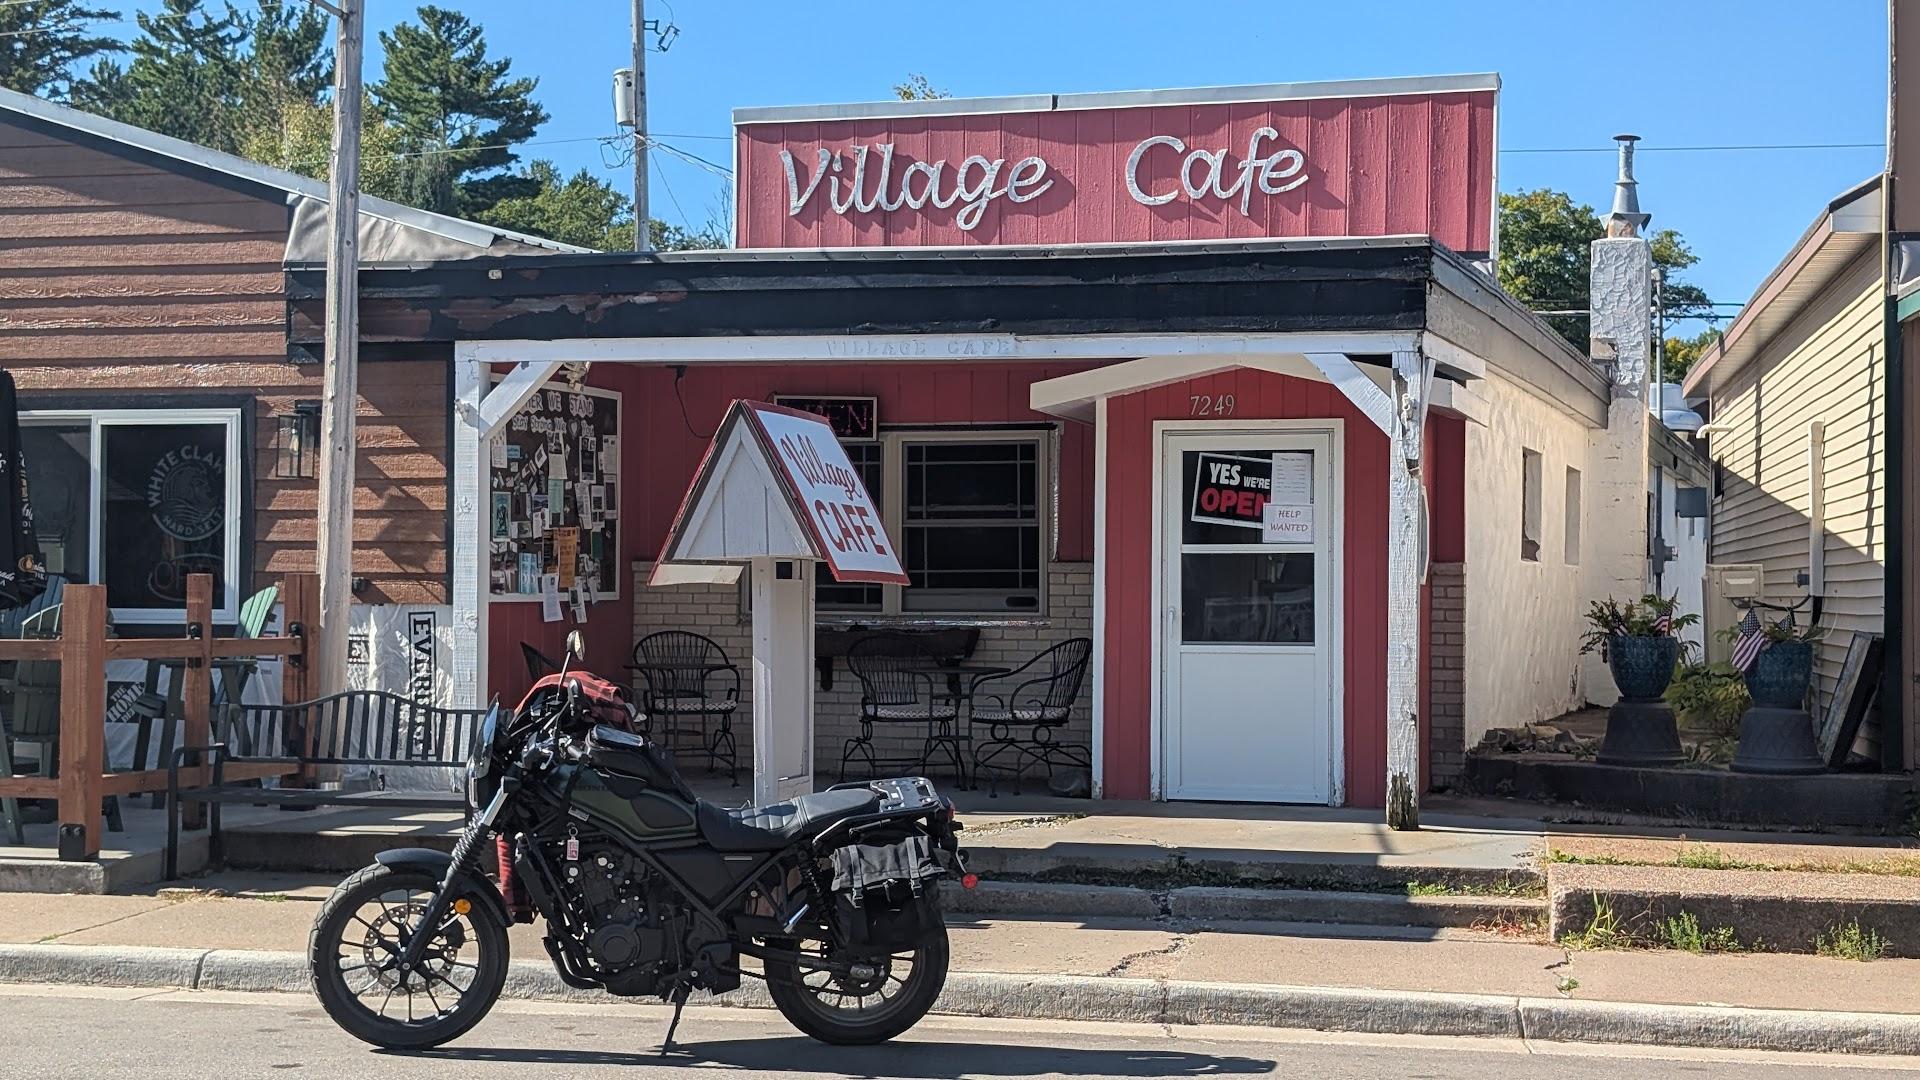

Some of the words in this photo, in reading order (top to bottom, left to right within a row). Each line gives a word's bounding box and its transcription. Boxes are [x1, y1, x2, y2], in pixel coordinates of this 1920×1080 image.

[777, 142, 1053, 230] Village
[1125, 126, 1309, 217] Cafe
[826, 340, 926, 356] VILLAGE
[948, 338, 1010, 355] CAFE
[548, 393, 562, 410] WE
[570, 395, 594, 416] STAND
[1190, 394, 1235, 416] 7249
[780, 432, 863, 501] Village
[1209, 462, 1242, 487] YES
[1243, 475, 1271, 490] WE'RE
[147, 450, 179, 508] WHITE
[162, 515, 193, 536] HARD
[1278, 510, 1302, 518] HELP
[814, 499, 887, 555] CAFE
[1270, 523, 1309, 532] WANTED
[106, 682, 145, 723] HOME
[110, 685, 127, 702] THE
